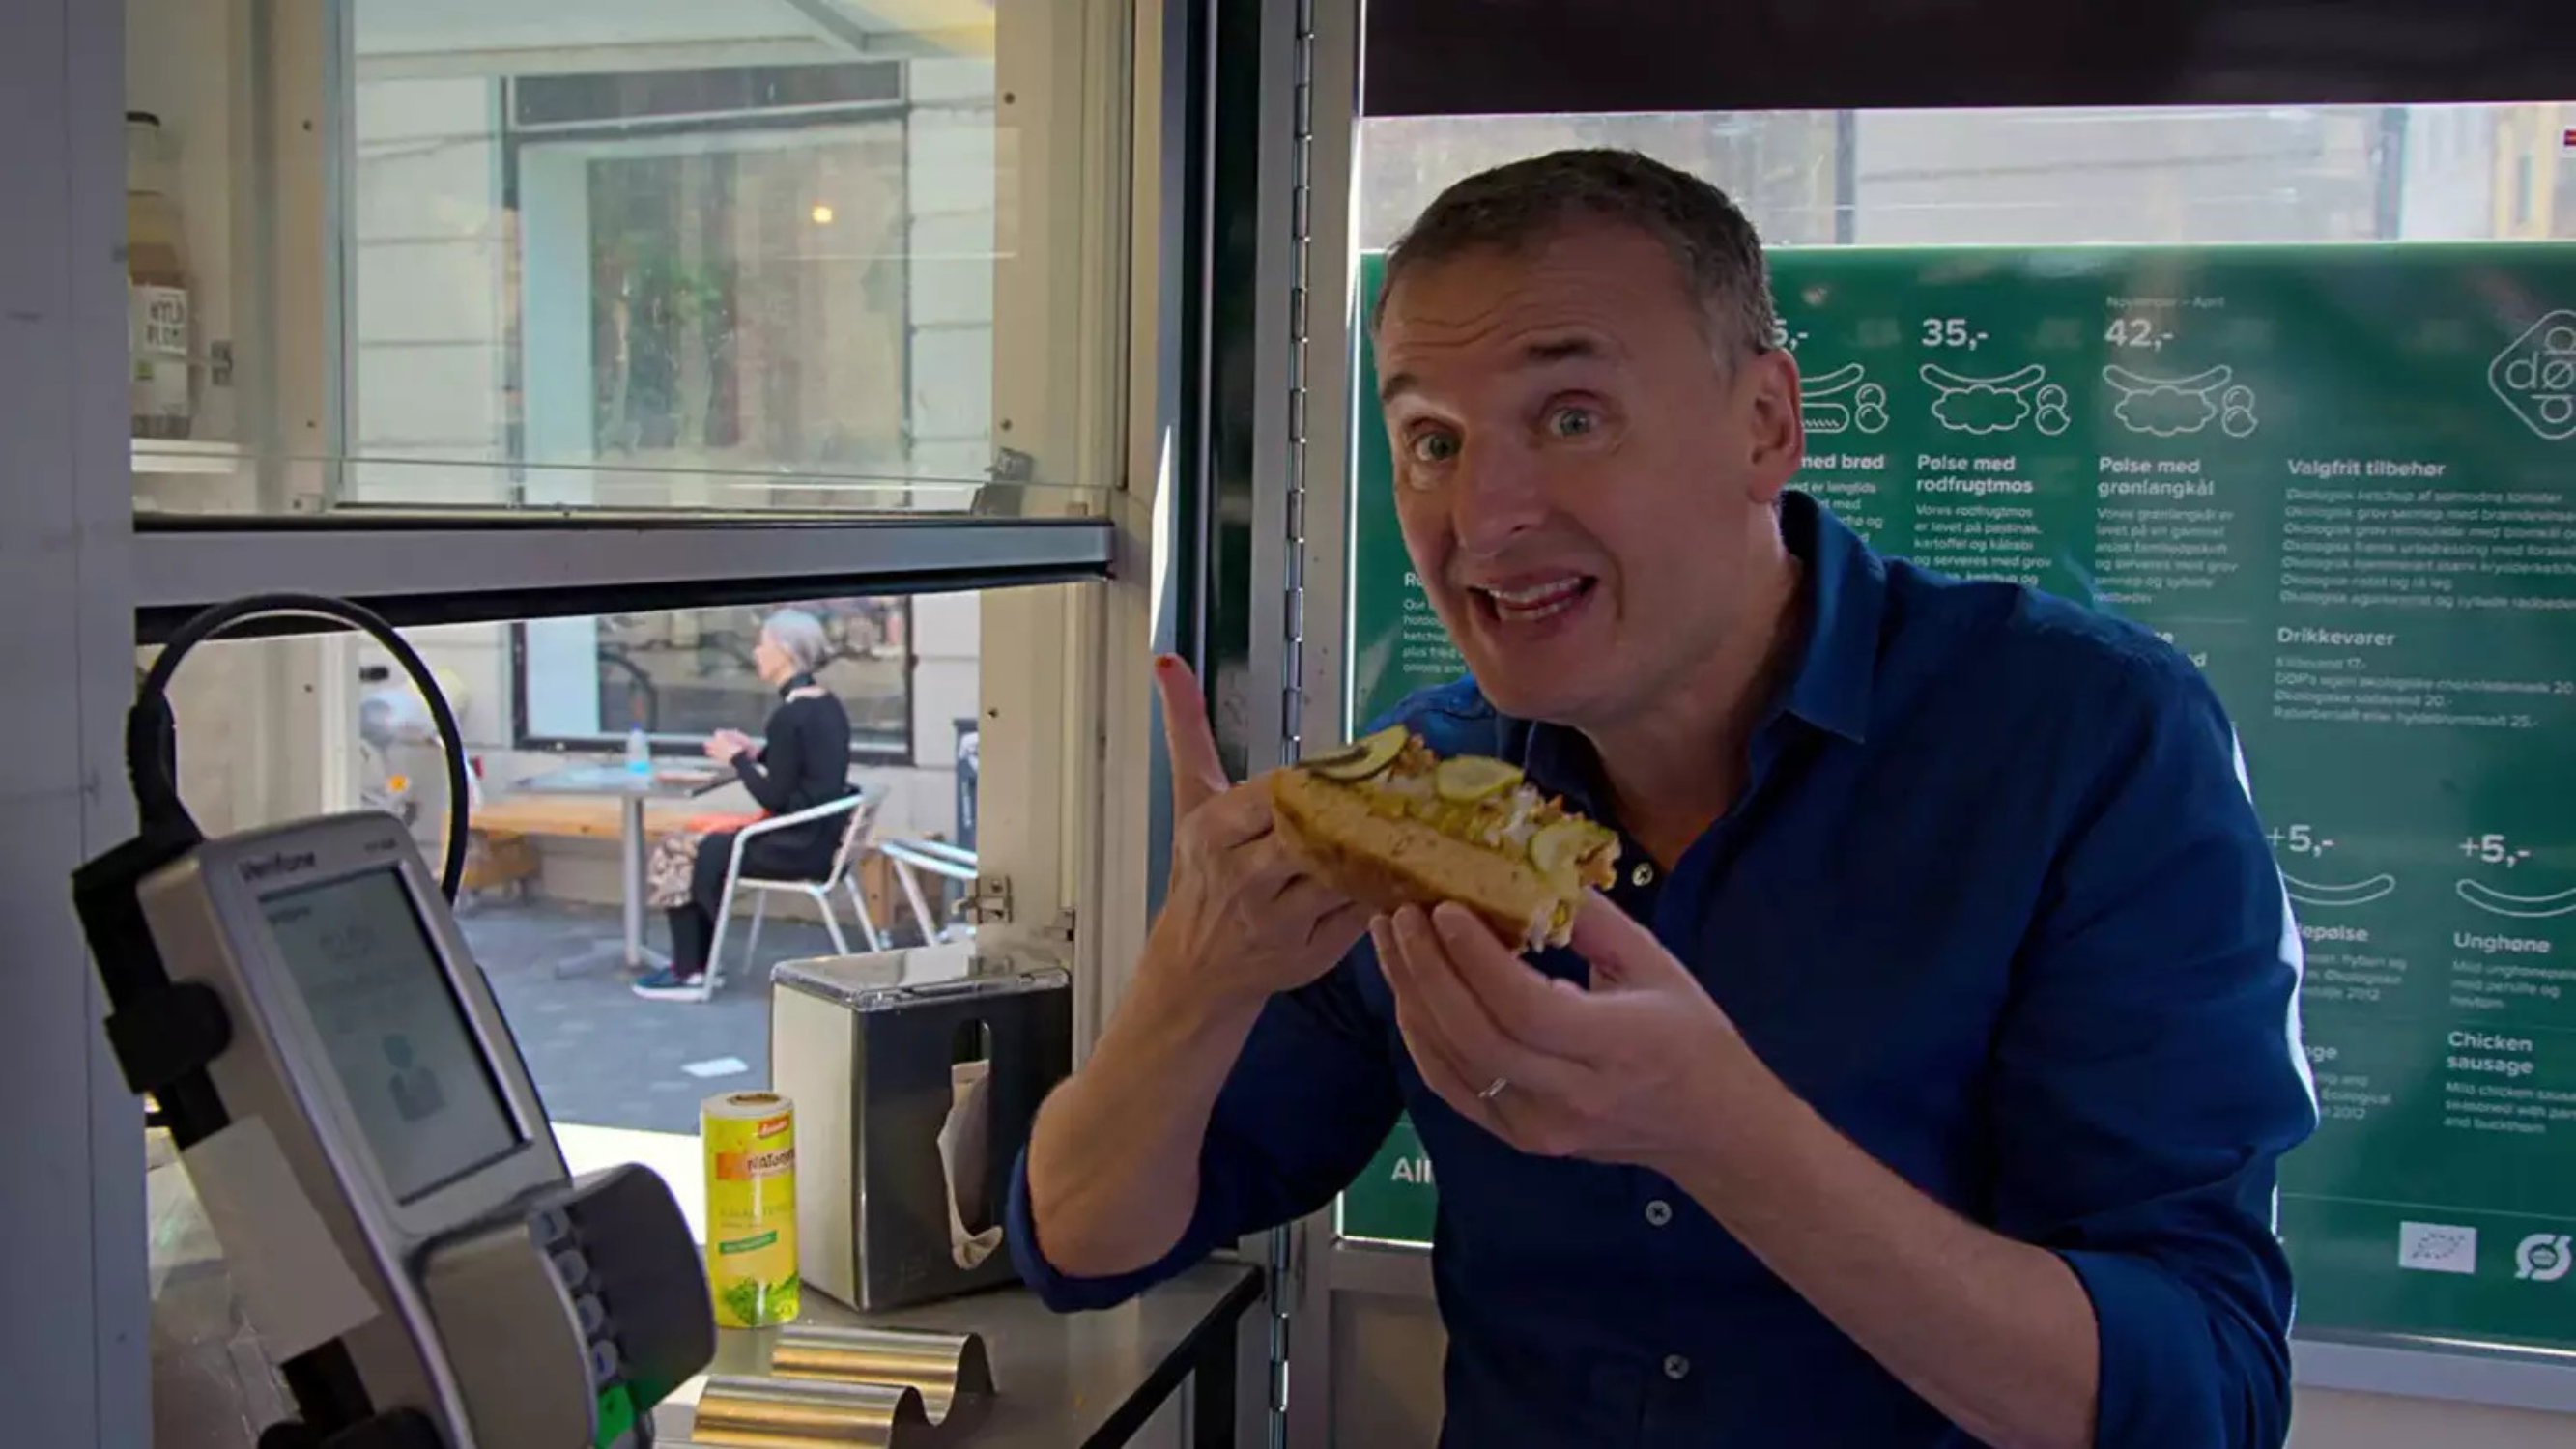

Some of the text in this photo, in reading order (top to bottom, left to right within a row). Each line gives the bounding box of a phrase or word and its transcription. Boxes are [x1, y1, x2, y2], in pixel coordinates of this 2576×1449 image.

[1921, 318, 1989, 352] 35,-
[2104, 318, 2175, 353] 42,-
[1973, 455, 2018, 472] med
[2157, 458, 2202, 474] med
[2287, 459, 2447, 479] Valgfrit tilbehør
[2277, 626, 2396, 646] Drikkevarer
[2266, 823, 2335, 858] +5,-
[2458, 833, 2532, 868] +5,-
[2447, 1030, 2533, 1052] Chicken
[2446, 1055, 2535, 1078] sausage
